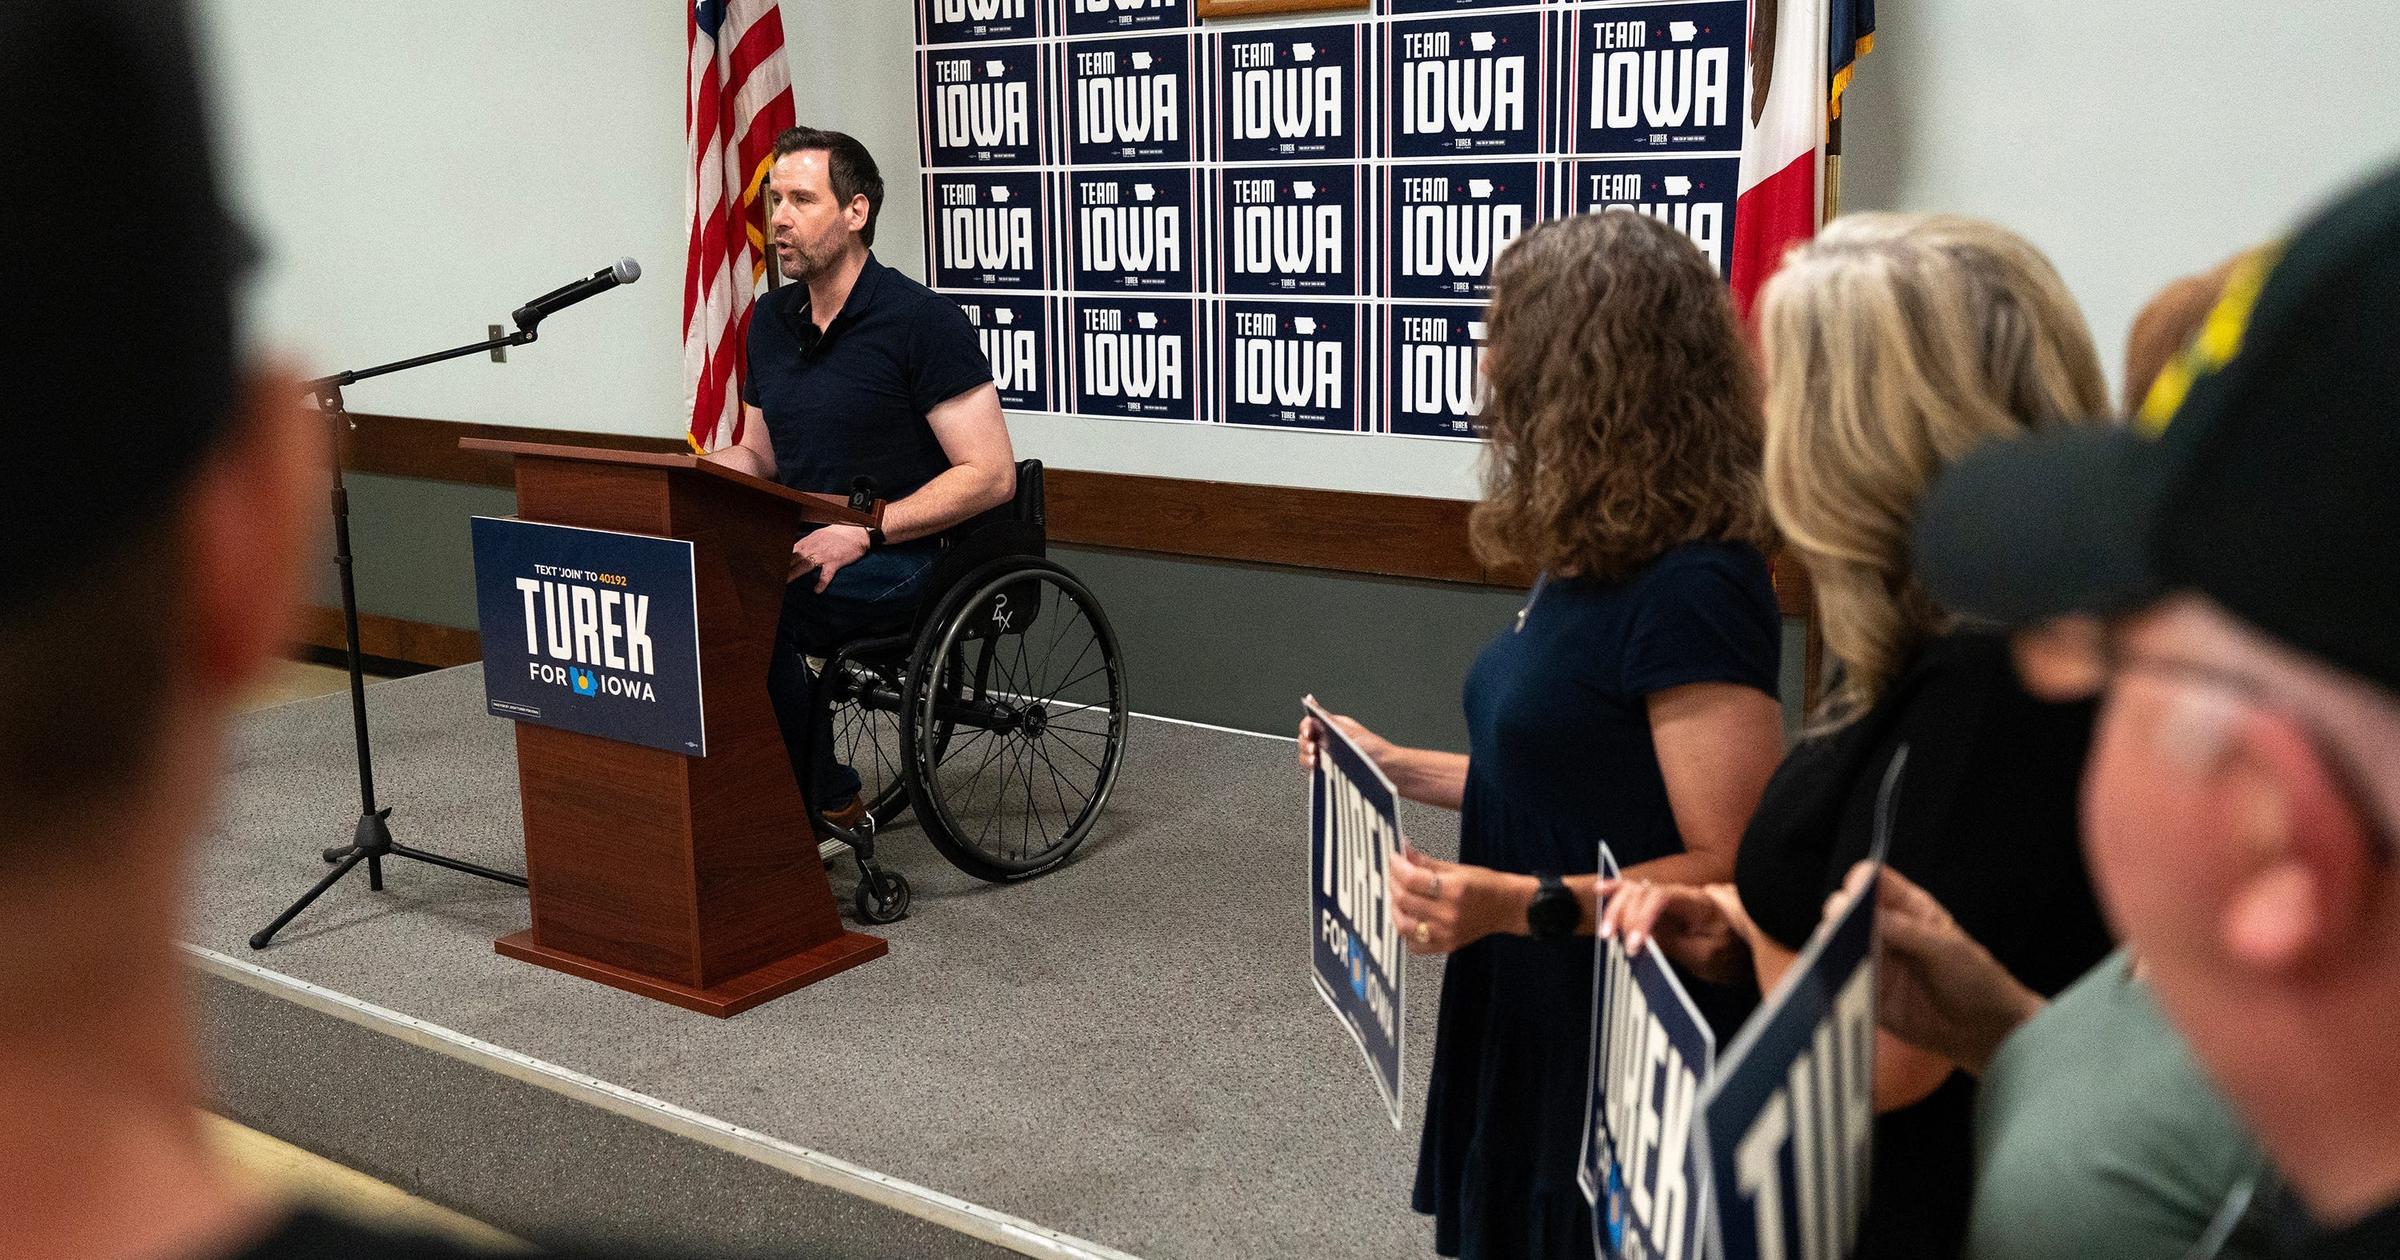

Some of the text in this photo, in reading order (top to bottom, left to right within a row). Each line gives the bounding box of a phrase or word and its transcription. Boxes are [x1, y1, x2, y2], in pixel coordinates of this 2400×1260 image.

[1232, 42, 1274, 68] TEAM
[1403, 31, 1450, 58] TEAM
[1593, 20, 1646, 49] TEAM
[936, 60, 971, 82] TEAM
[1077, 52, 1115, 76] TEAM
[1590, 47, 1729, 130] IOWA
[936, 82, 1029, 148] IOWA
[1077, 73, 1178, 144] IOWA
[1232, 65, 1342, 140] IOWA
[1403, 56, 1525, 135] IOWA
[941, 183, 976, 206] TEAM
[1080, 181, 1119, 205] TEAM
[1233, 179, 1275, 204] TEAM
[1402, 177, 1449, 203] TEAM
[1590, 174, 1641, 201] TEAM
[941, 207, 1034, 271] IOWA
[1080, 205, 1180, 272] IOWA
[1233, 204, 1342, 274] IOWA
[1402, 204, 1523, 277] IOWA
[1083, 308, 1122, 332] TEAM
[1235, 312, 1277, 337] TEAM
[1402, 317, 1448, 342] TEAM
[979, 329, 1037, 392] WA
[1084, 332, 1183, 400] IOWA
[1235, 338, 1343, 409] IOWA
[1402, 344, 1488, 416] IOW
[534, 564, 627, 586] TEXT 'JOIN' TO 40192
[516, 577, 655, 675] TUREK
[530, 662, 656, 702] FOR IOWA
[1322, 909, 1349, 968] FOR
